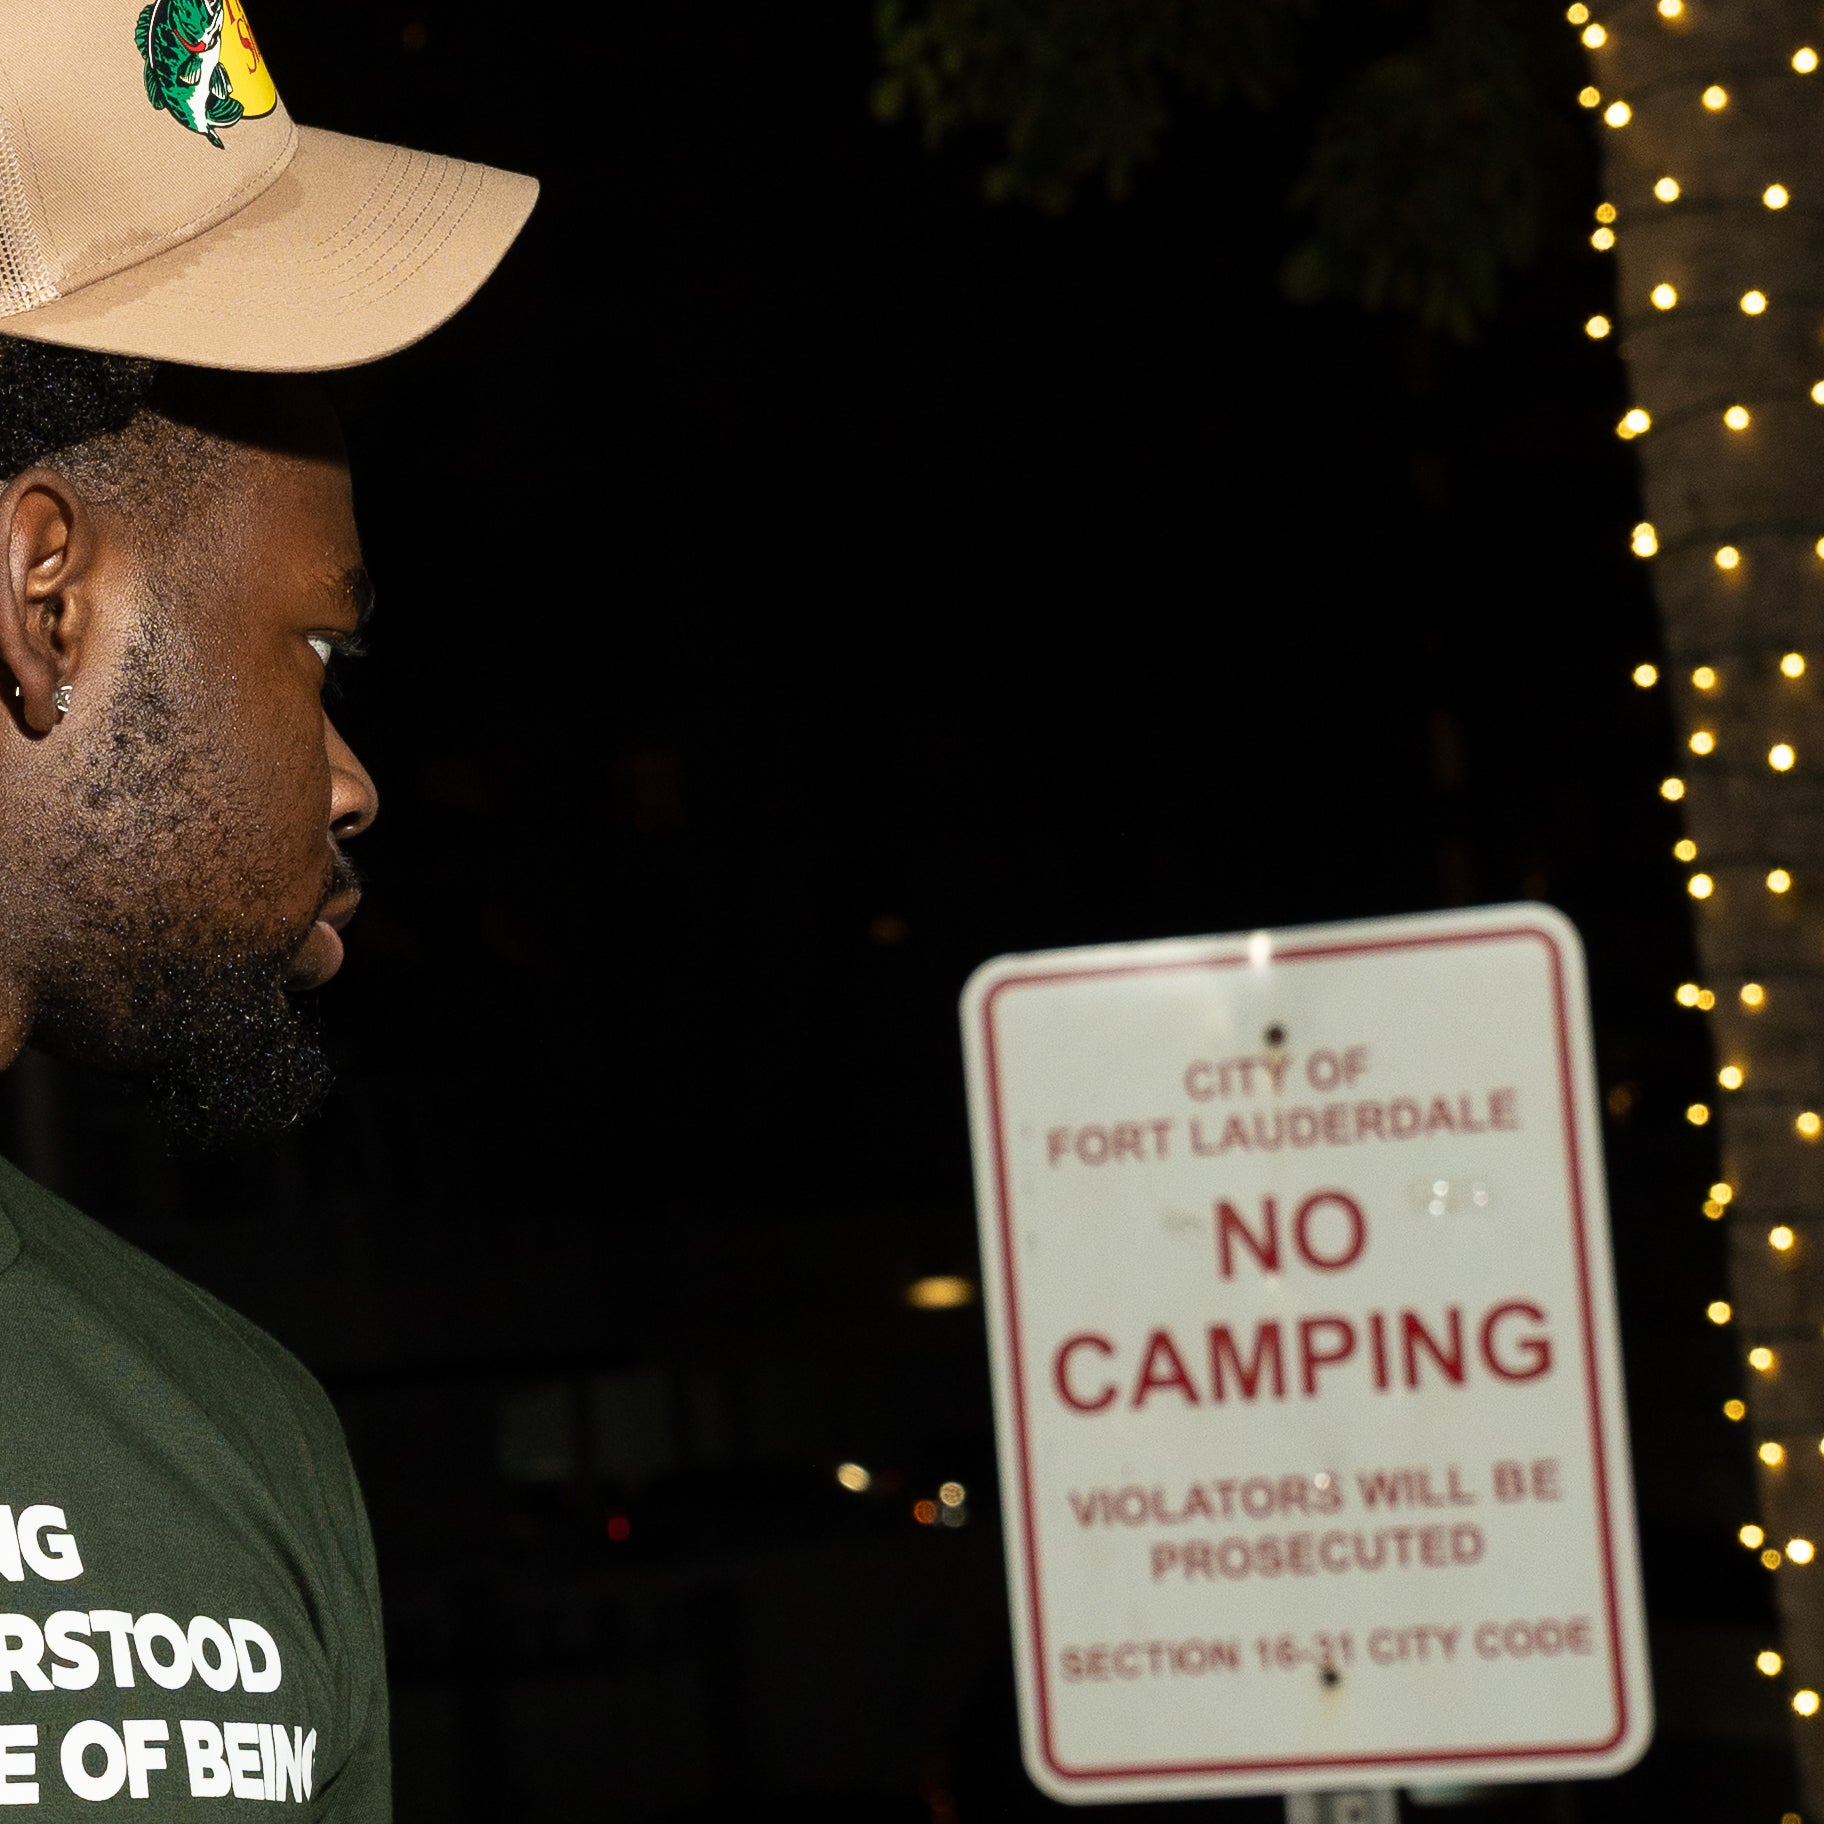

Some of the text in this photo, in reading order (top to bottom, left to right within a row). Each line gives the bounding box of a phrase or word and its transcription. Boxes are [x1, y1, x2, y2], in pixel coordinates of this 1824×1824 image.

[1183, 1046, 1370, 1103] CITY OF
[1046, 1088, 1521, 1168] FORT LAUDERDALE
[1213, 1188, 1369, 1280] NO
[1051, 1298, 1554, 1416] CAMPING
[1066, 1458, 1563, 1530] VIOLATORS WILL BE
[1149, 1522, 1487, 1582] PROSECUTED
[1059, 1636, 1242, 1683] SECTION
[1366, 1622, 1461, 1666] CITY
[1473, 1614, 1594, 1658] CODE
[60, 1719, 170, 1802] OF
